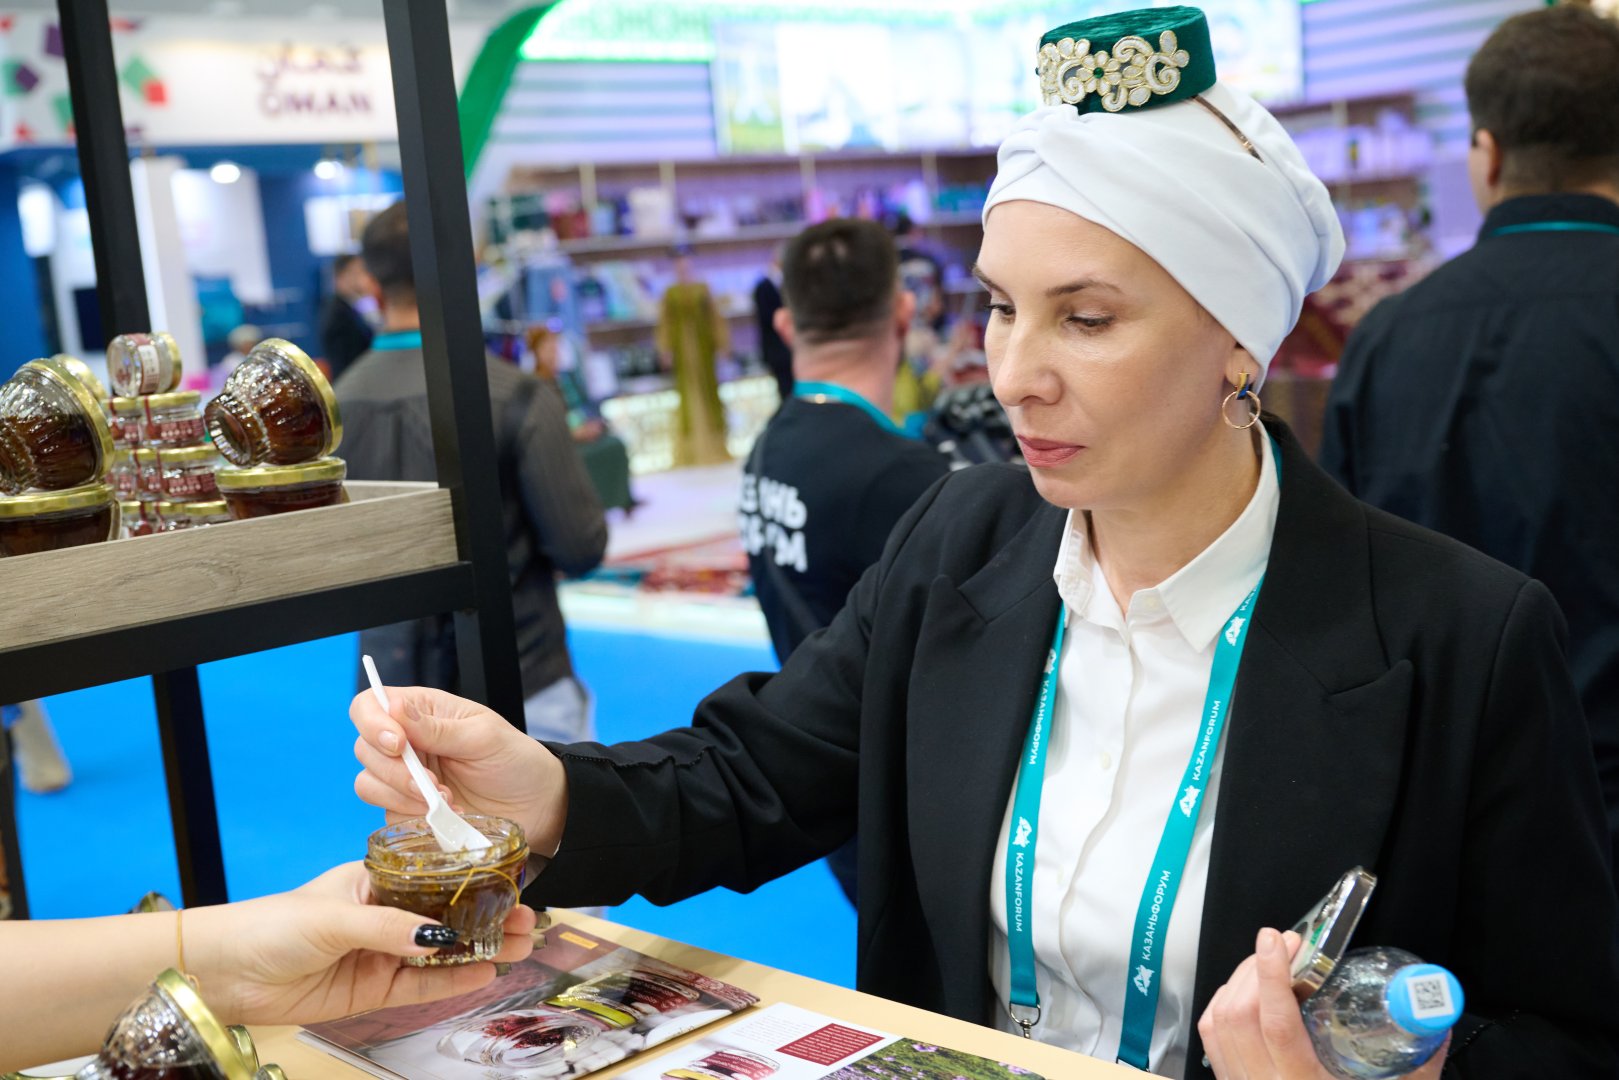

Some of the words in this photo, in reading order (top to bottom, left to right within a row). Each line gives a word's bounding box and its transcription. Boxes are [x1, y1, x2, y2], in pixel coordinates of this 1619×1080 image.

[258, 91, 373, 118] OMAN
[1029, 679, 1049, 765] КАЗАНЬФОРУМ
[1192, 699, 1222, 781] KAZANFORUM
[1014, 852, 1024, 932] KAZANFORUM
[1142, 870, 1171, 961] КАЗАНЬФОРУМ
